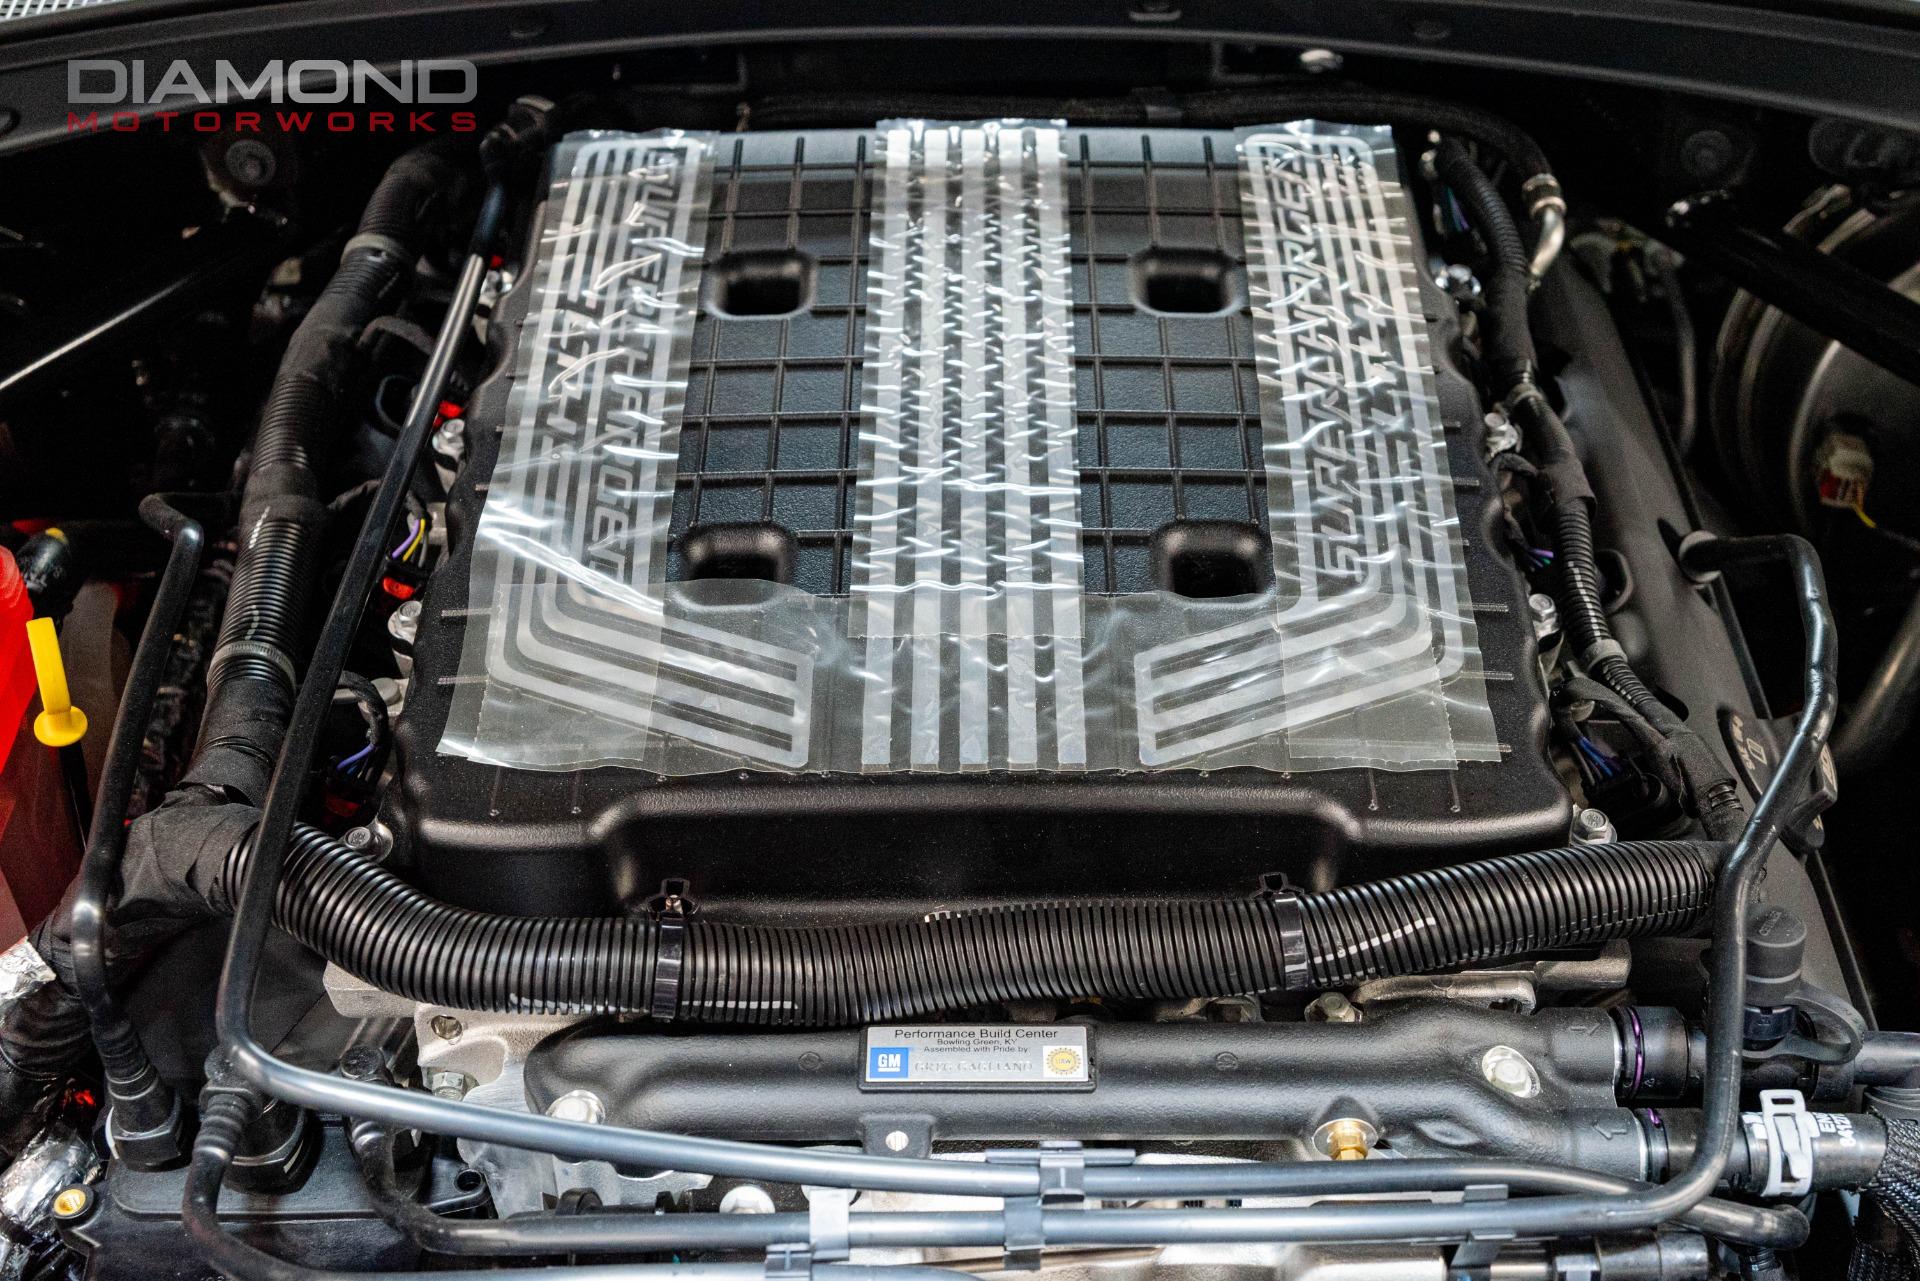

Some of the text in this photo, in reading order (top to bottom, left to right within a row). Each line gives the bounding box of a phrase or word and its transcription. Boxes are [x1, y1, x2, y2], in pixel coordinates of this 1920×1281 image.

[894, 1028, 1058, 1039] Performance Build Center
[937, 1038, 971, 1046] Bowling
[877, 1053, 901, 1069] GM
